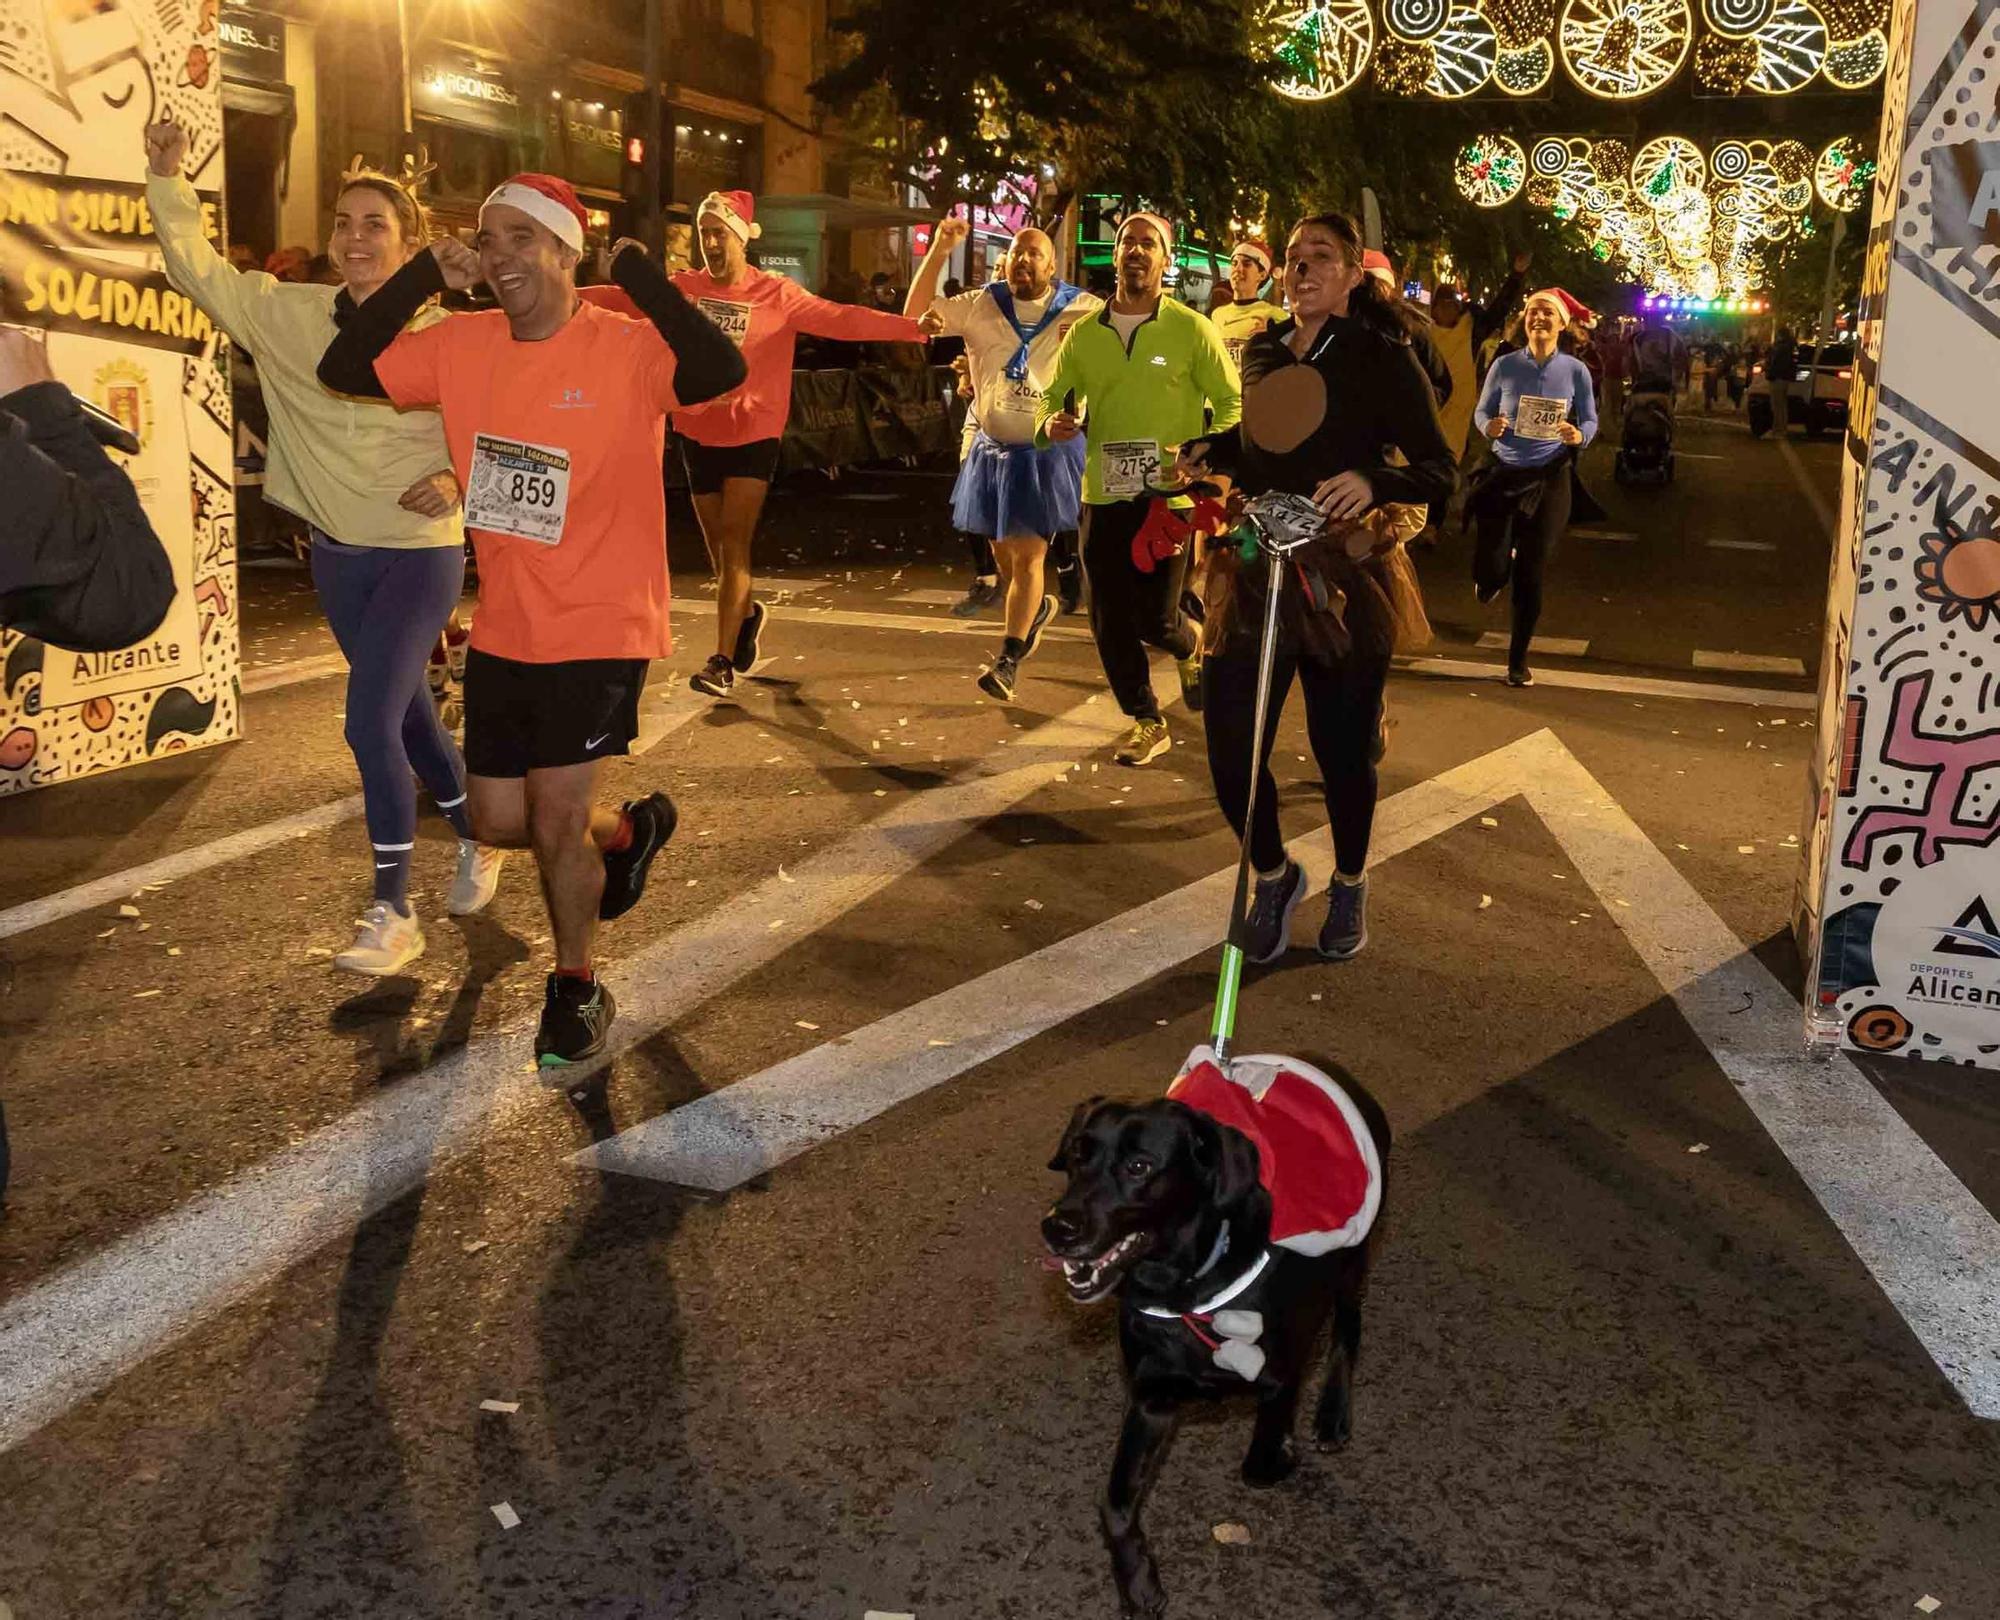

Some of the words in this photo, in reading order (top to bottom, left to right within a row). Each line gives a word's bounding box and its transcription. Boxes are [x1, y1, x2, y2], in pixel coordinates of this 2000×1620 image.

[67, 189, 219, 239] SILVEE
[25, 261, 213, 342] SOLIDARIA
[511, 473, 556, 508] 859
[72, 641, 180, 679] Alicante
[1909, 963, 1974, 979] DEPORTES
